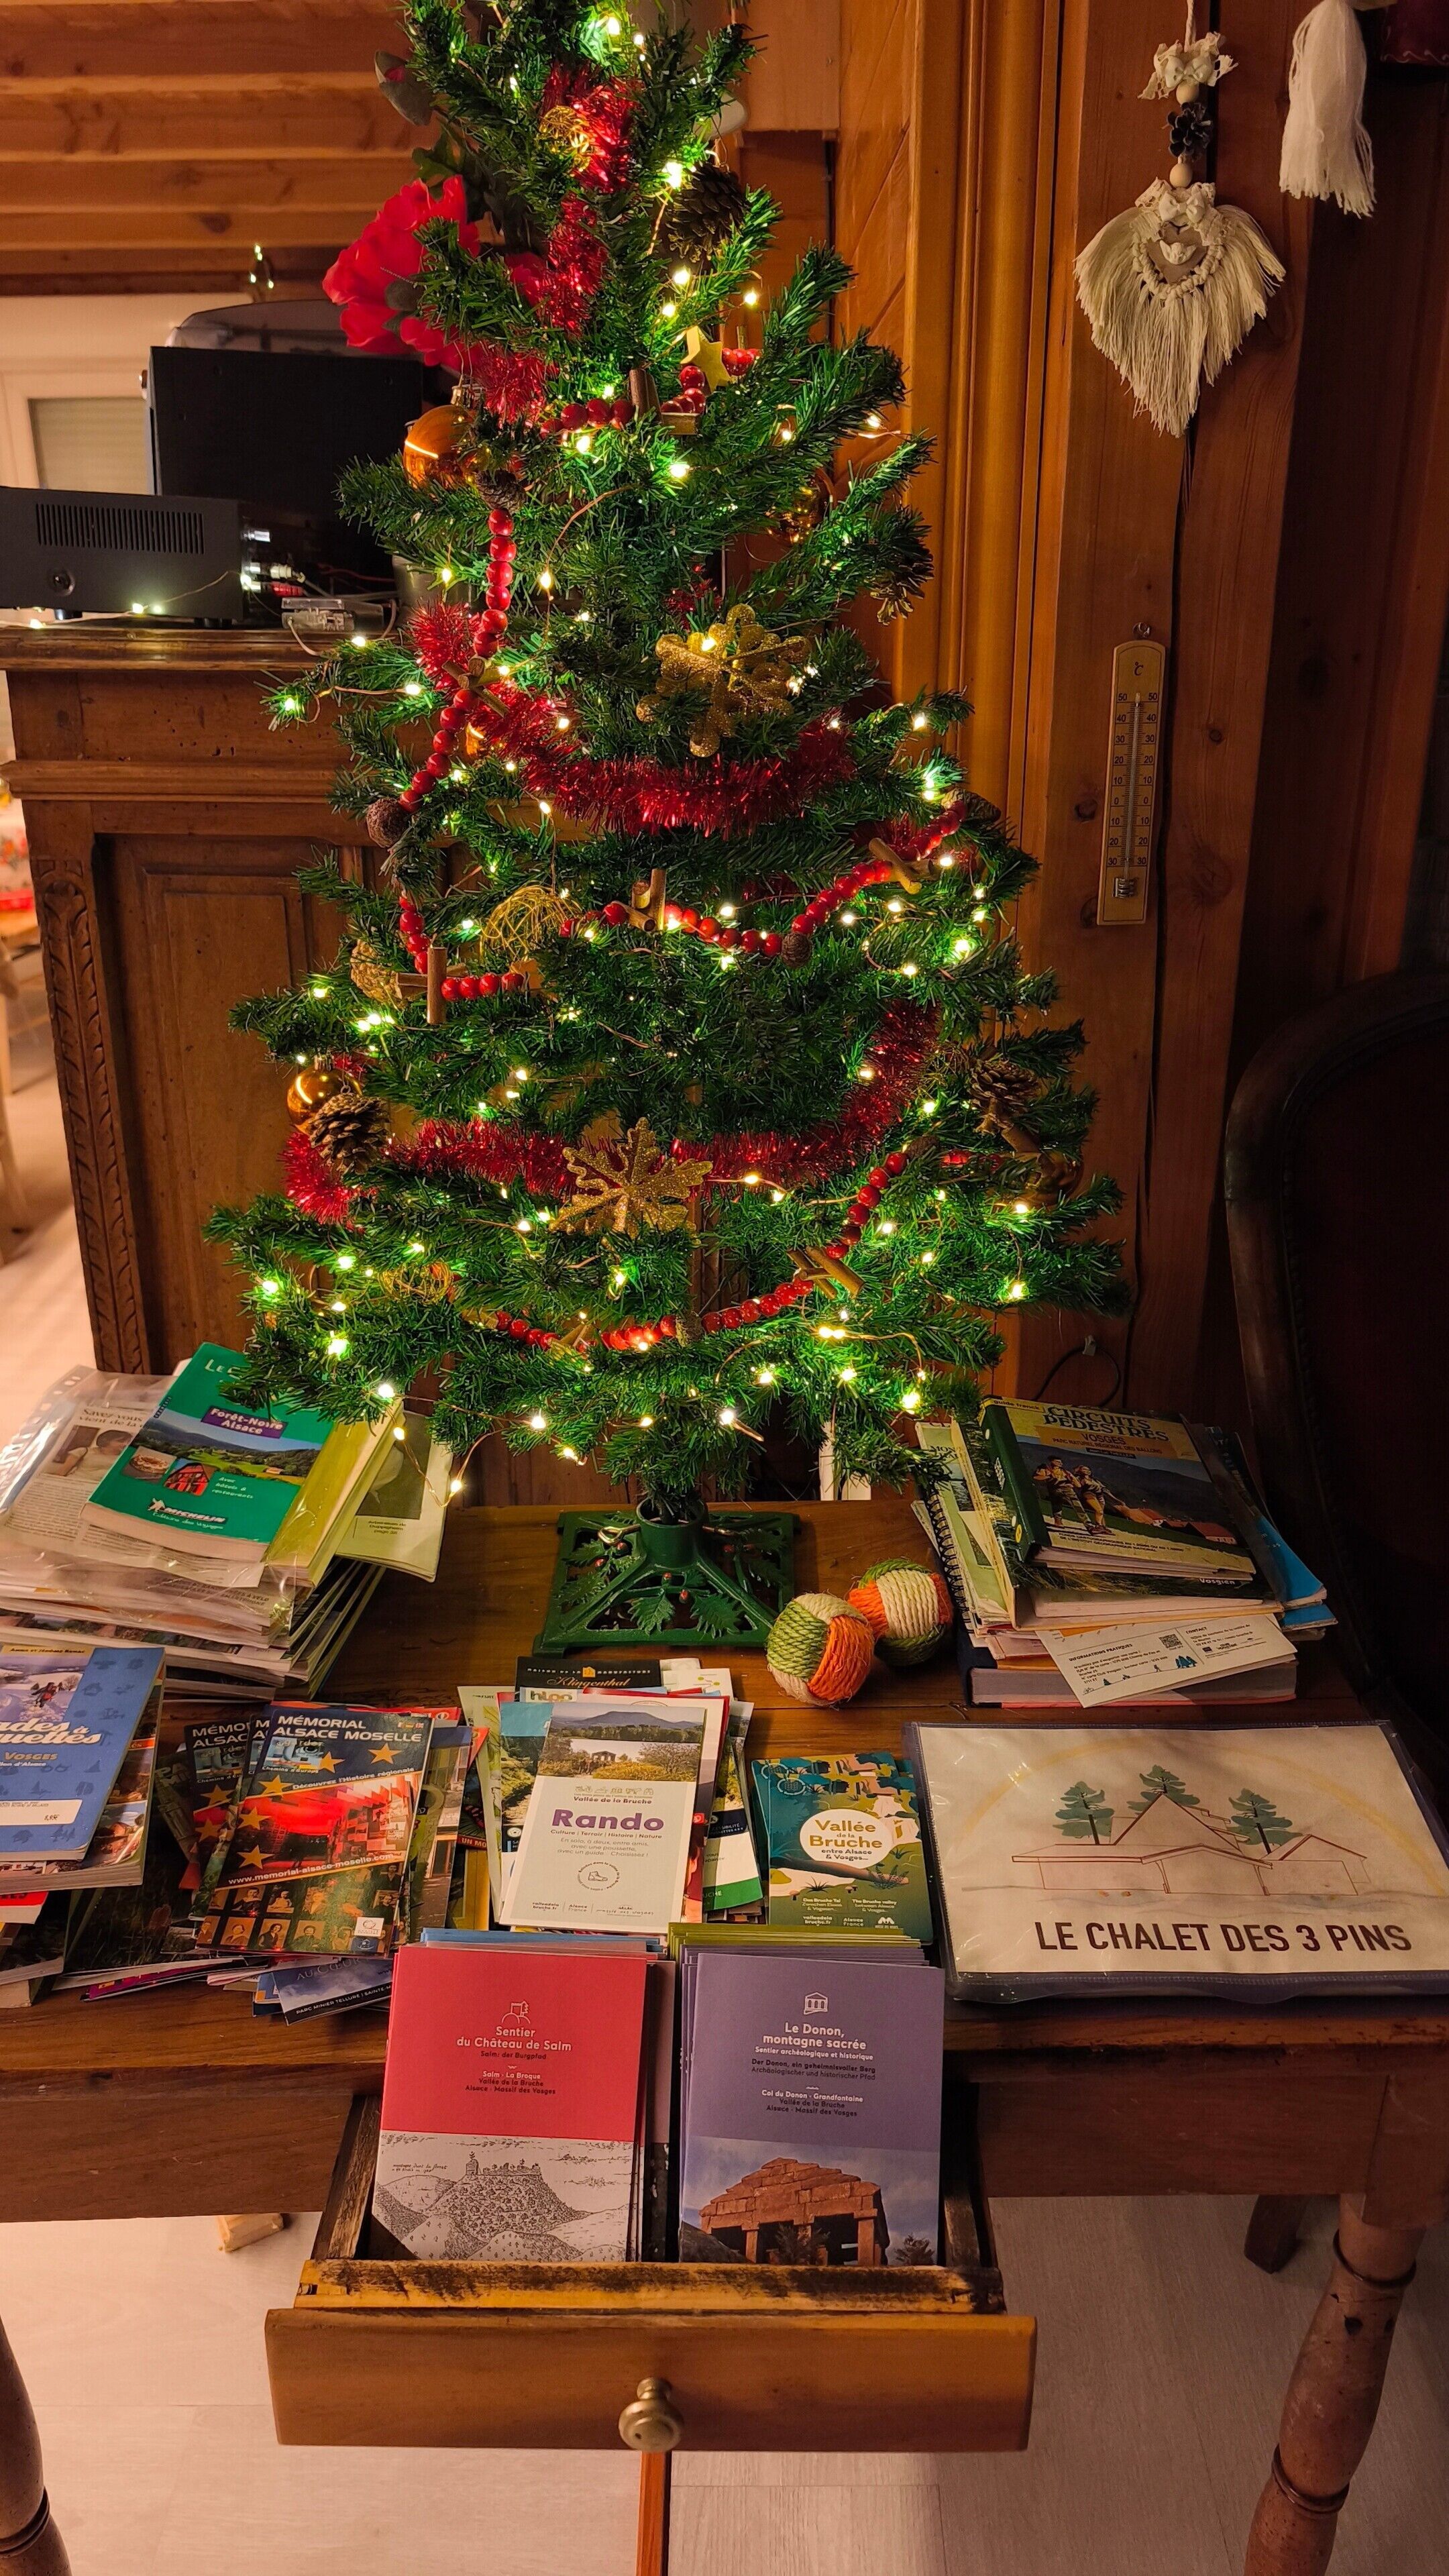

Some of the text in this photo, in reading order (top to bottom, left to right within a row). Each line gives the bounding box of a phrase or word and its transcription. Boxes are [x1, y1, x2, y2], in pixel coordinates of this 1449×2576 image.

[1118, 693, 1128, 701] 50
[1148, 692, 1158, 700] 50
[1116, 714, 1126, 722] 40
[1146, 714, 1157, 722] 40
[1115, 735, 1125, 743] 30
[1145, 735, 1155, 743] 30
[1114, 756, 1124, 764] 20
[1144, 755, 1153, 763] 20
[1114, 777, 1122, 785] 10
[1143, 776, 1152, 784] 10
[1114, 797, 1119, 805] 0
[1143, 797, 1148, 805] 0
[1111, 817, 1120, 825] 10
[1140, 816, 1149, 824] 10
[1109, 837, 1118, 845] 20
[1138, 837, 1148, 845] 20
[1108, 857, 1118, 865] 30
[1137, 857, 1147, 865] 30
[1047, 1405, 1151, 1430] CIRCUITS
[221, 1419, 263, 1435] Alsace
[1081, 1432, 1127, 1445] VOSGES
[164, 1507, 226, 1523] MICHELIN
[1199, 1577, 1235, 1585] Vosgien
[1185, 1627, 1208, 1635] CONTACT
[1069, 1643, 1133, 1662] INFORMATIONS PRATIQUES
[546, 1676, 631, 1688] Klingenthal
[278, 1715, 366, 1729] MÉMORIAL
[193, 1721, 250, 1737] MÉMO
[273, 1727, 339, 1739] ALSACE
[344, 1731, 423, 1742] MOSELLE
[193, 1733, 248, 1748] ALSAC
[292, 1779, 336, 1790] Découvrez
[377, 1766, 415, 1778] régionale
[552, 1809, 664, 1831] Rando
[815, 1819, 876, 1833] Vallée
[809, 1835, 883, 1848] Bruche
[228, 1854, 394, 1884] www.memorial-alsace-moselle.com
[1035, 1921, 1412, 1951] LE CHALET DES 3 PINS
[297, 1970, 313, 1980] AU
[296, 2006, 312, 2015] PARC
[313, 2000, 335, 2010] MINIER
[364, 1984, 392, 1996] SAINTE-M
[496, 2026, 536, 2037] Sentier
[785, 2021, 845, 2038] Le Donon,
[456, 2036, 572, 2051] du Château de Salm
[763, 2035, 867, 2050] montagne sacrée
[480, 2050, 500, 2058] Salm:
[515, 2052, 547, 2060] Burgpfad
[755, 2045, 779, 2054] Sentier
[781, 2048, 829, 2058] archéologique
[839, 2051, 873, 2061] historique
[765, 2059, 790, 2068] Donon,
[804, 2062, 857, 2072] geheimnisvoller
[859, 2065, 875, 2074] Berg
[482, 2070, 500, 2078] Salm
[517, 2072, 541, 2081] Broque
[751, 2067, 804, 2076] Archäologischer
[820, 2072, 858, 2080] historischer
[813, 2093, 863, 2102] Grandfontaine
